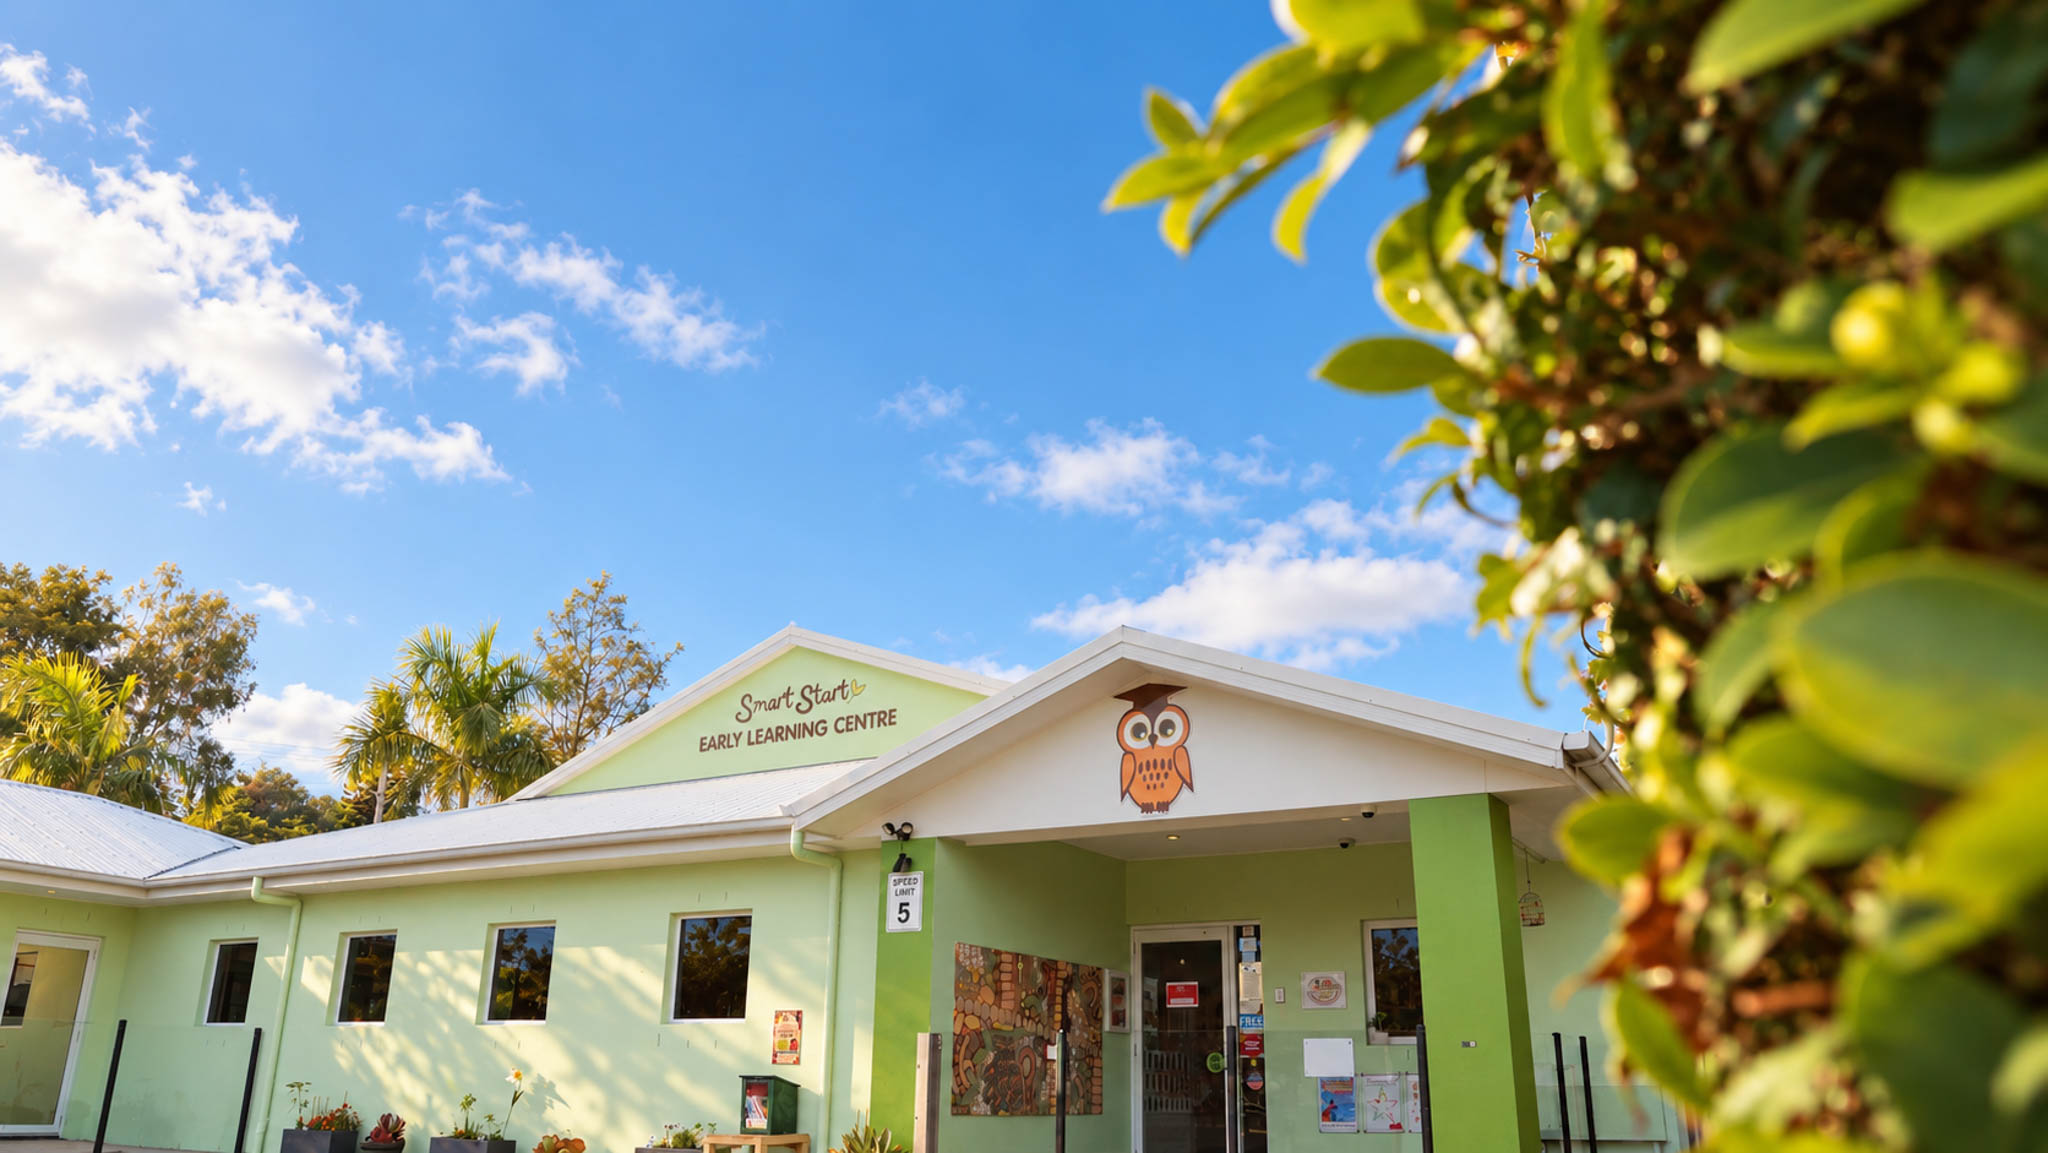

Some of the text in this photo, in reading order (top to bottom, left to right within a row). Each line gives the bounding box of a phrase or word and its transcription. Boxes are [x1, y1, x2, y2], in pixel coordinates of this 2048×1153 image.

[735, 679, 849, 723] Smart Start
[699, 708, 897, 753] EARLY LEARNING CENTRE
[892, 877, 918, 887] SPEED
[894, 887, 915, 897] LIMIT
[897, 902, 910, 923] 5
